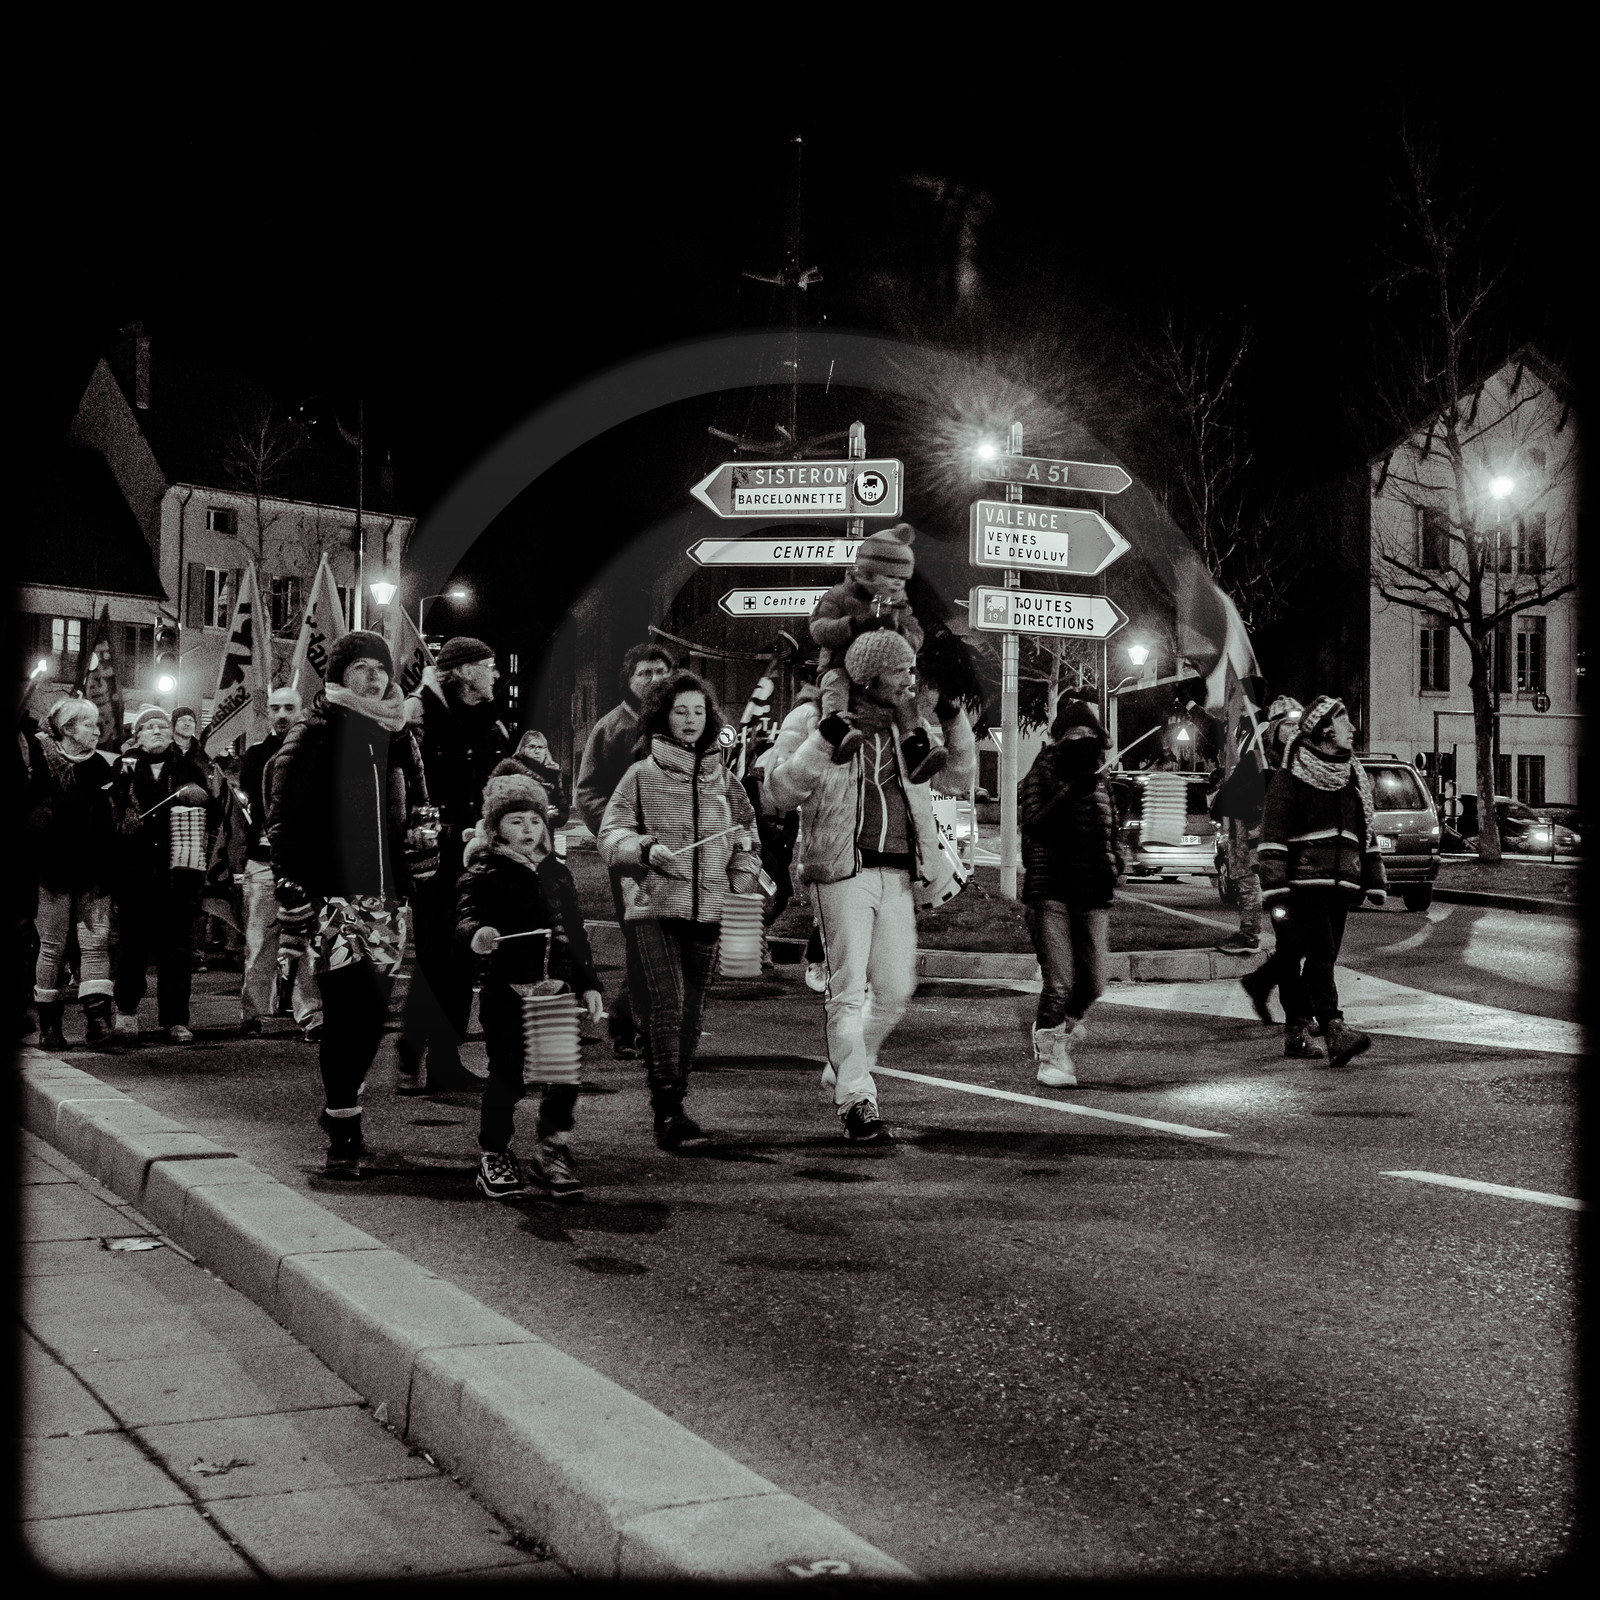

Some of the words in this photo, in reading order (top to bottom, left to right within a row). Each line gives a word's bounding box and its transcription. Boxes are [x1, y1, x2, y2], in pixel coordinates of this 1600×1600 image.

[755, 468, 847, 484] SISTERON
[1026, 464, 1040, 480] A
[1048, 466, 1069, 482] 51
[738, 494, 842, 505] BARCELONNETTE
[986, 508, 1058, 529] VALENCE
[988, 532, 1037, 545] VEYNES
[773, 546, 835, 558] CENTRE
[988, 546, 1000, 555] LE
[1009, 548, 1065, 561] DEVOLUY
[764, 596, 805, 605] Centre
[1014, 597, 1072, 612] TOUTES
[1014, 614, 1094, 630] DIRECTIONS
